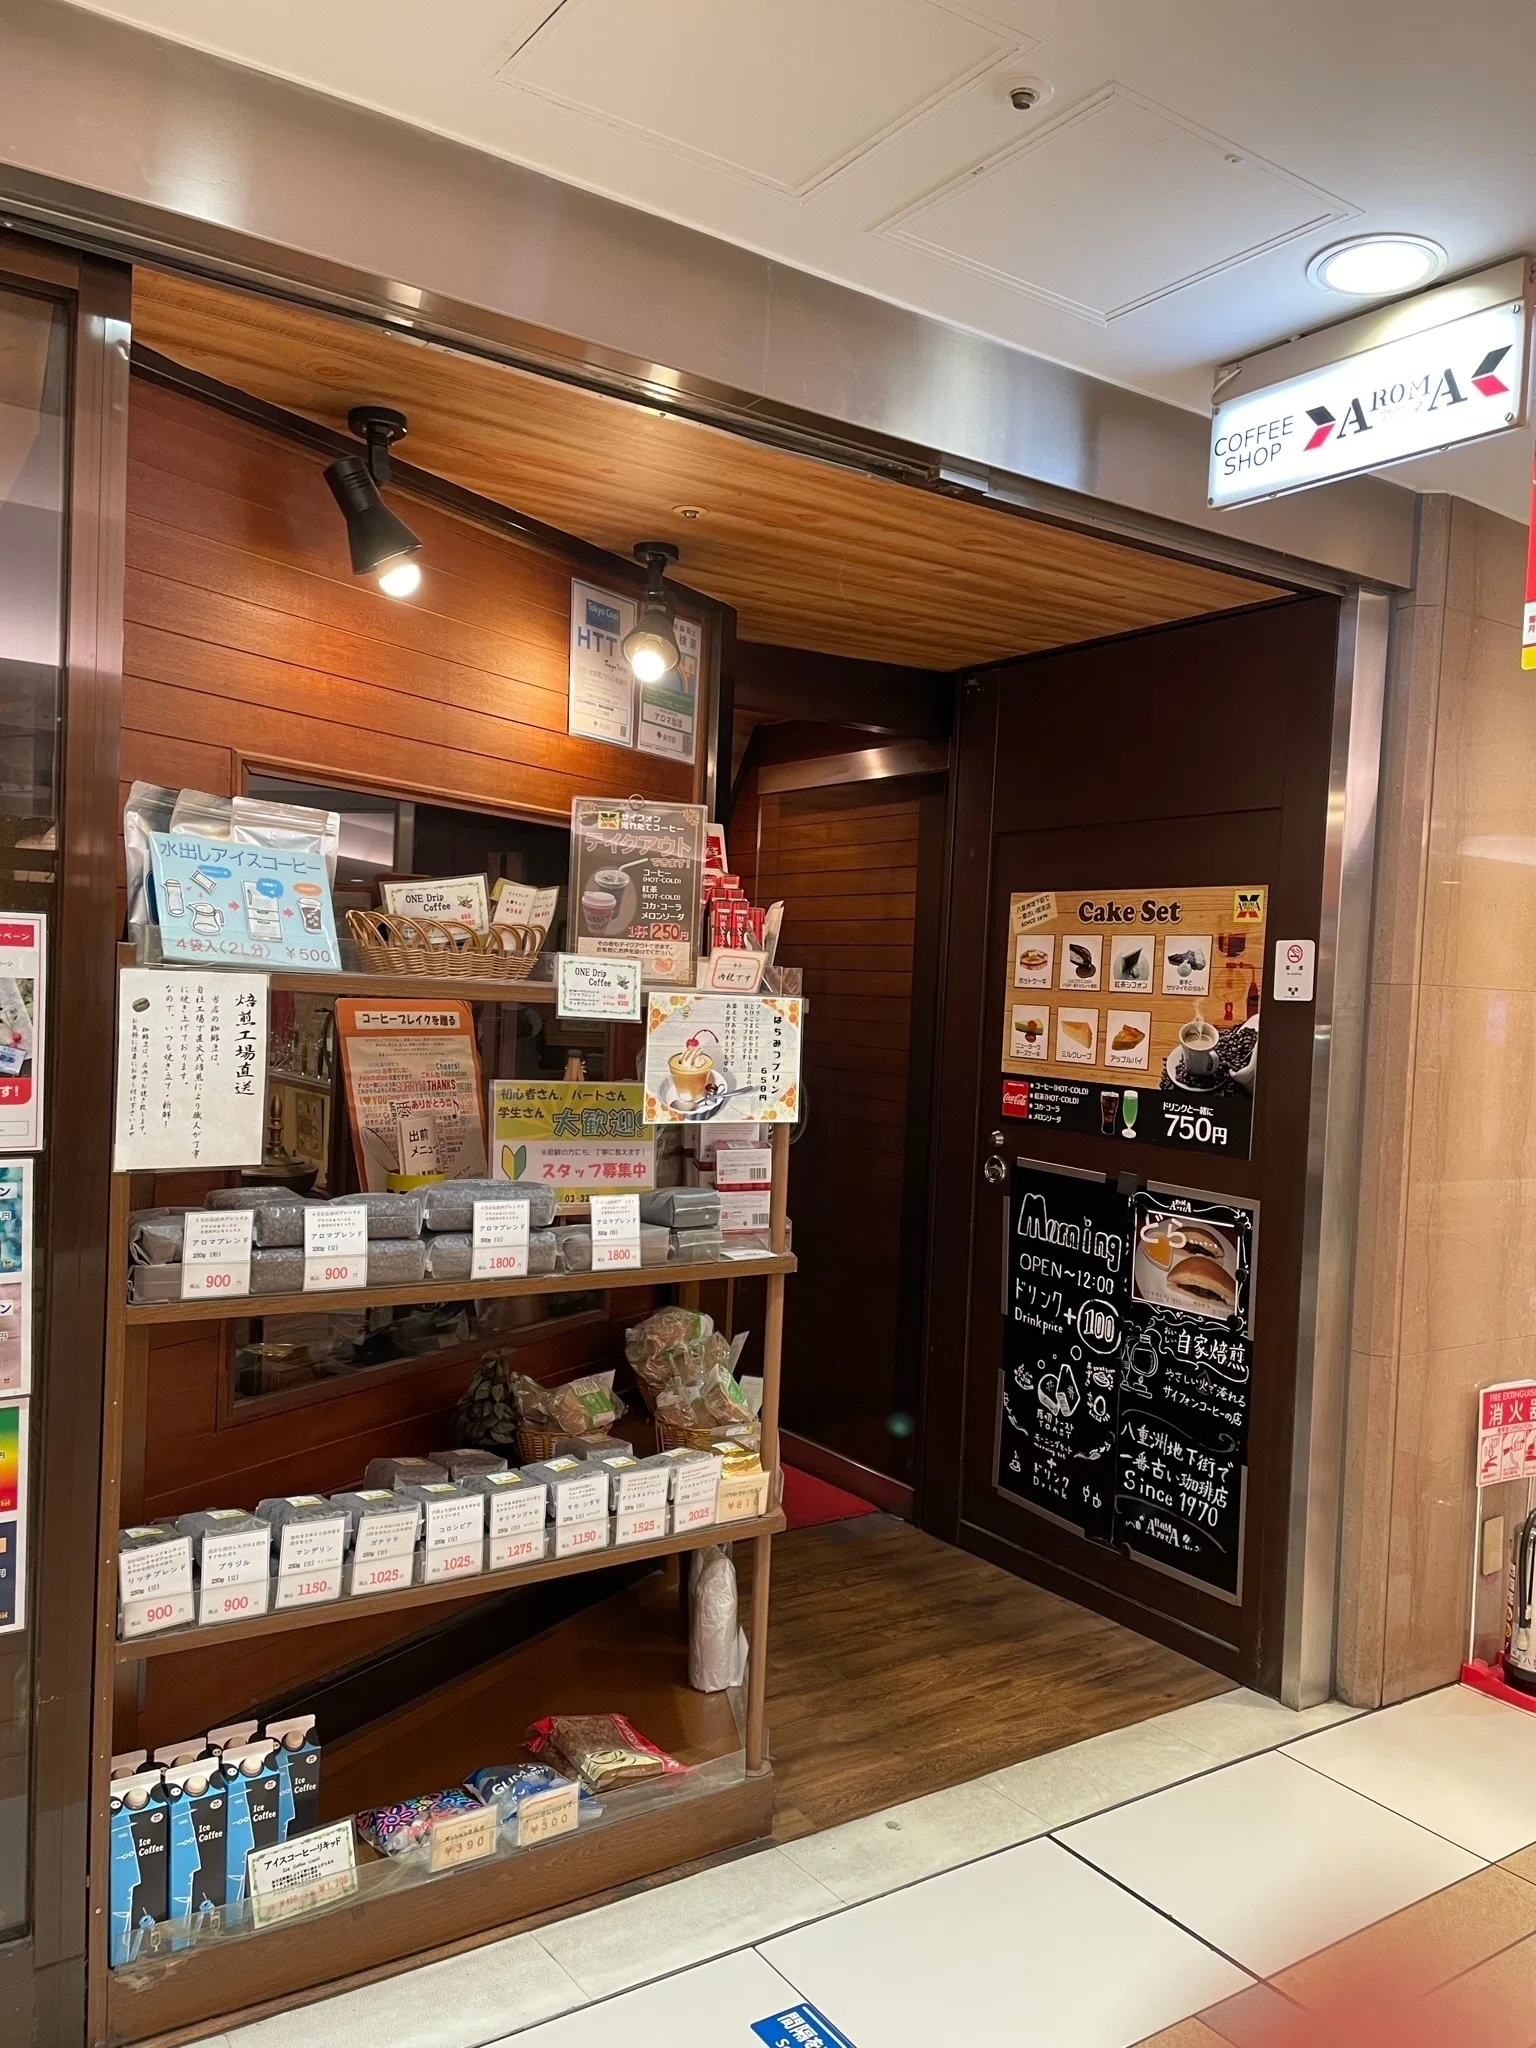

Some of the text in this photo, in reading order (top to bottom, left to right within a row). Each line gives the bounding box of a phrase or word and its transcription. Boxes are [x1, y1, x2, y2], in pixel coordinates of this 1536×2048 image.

[1336, 367, 1469, 440] AROMA
[1214, 415, 1295, 457] COFFEE
[1223, 442, 1283, 476] SHOP
[577, 626, 618, 657] HTT
[621, 813, 661, 823] サイフォン
[584, 831, 692, 858] テイクアウト
[159, 840, 321, 875] 水出しアイスコーヒー
[642, 869, 672, 877] コーヒー
[642, 885, 658, 893] 紅茶
[405, 893, 445, 905] ONE Drip
[423, 902, 451, 913] Coffee
[641, 902, 682, 911] コカ・コーラ
[1078, 899, 1182, 923] Cake Set
[641, 912, 685, 921] メロンソーダ
[176, 938, 331, 963] 4袋入(2L分) ¥500
[574, 967, 607, 978] ONE Drip
[588, 977, 612, 988] Coffee
[1018, 977, 1047, 985] ホットケーキ
[1114, 980, 1148, 989] 紅茶シフォン
[362, 1013, 456, 1027] コーヒーブレイクを贈る
[234, 992, 258, 1097] 焙煎工場直送
[1015, 1042, 1041, 1050] ニューヨーク
[771, 1016, 783, 1095] はちみつプリン
[1015, 1049, 1040, 1057] チーズケーキ
[1061, 1050, 1092, 1060] ミルクレープ
[1110, 1054, 1143, 1065] アップルパイ
[435, 1062, 461, 1071] Cheers!
[426, 1079, 457, 1092] THANKS
[758, 1067, 768, 1101] 650円
[411, 1099, 447, 1109] ありがとう
[1034, 1103, 1061, 1113] コカ・コーラ
[1162, 1100, 1214, 1117] ドリンクと一緒に
[497, 1106, 545, 1119] 学生さん
[1033, 1113, 1062, 1124] メロンソーダ
[408, 1127, 429, 1143] 出前
[1163, 1113, 1228, 1145] 750円
[542, 1162, 647, 1179] スタッフ募集中
[479, 1224, 525, 1233] アロマブレンド
[596, 1218, 637, 1226] アロマブレンド
[311, 1231, 363, 1240] アロマブレンド
[1139, 1212, 1188, 1249] どら
[192, 1237, 249, 1247] アロマブレンド
[608, 1249, 631, 1261] 1800
[489, 1257, 515, 1269] 1800
[324, 1266, 348, 1280] 900
[205, 1274, 231, 1289] 900
[1015, 1277, 1063, 1317] ドリンク
[1177, 1327, 1246, 1373] 自家焙煎
[1119, 1421, 1235, 1483] 八重洲地下街で
[1119, 1451, 1229, 1509] 一番古い珈琲店
[1122, 1469, 1218, 1527] Since 1970
[688, 1507, 710, 1522] 2025
[439, 1522, 473, 1533] コロンビア
[632, 1520, 655, 1534] 1525
[571, 1531, 597, 1546] 1150
[295, 1545, 333, 1556] マンデリン
[507, 1543, 533, 1558] 1275
[219, 1559, 250, 1571] ブラジル
[443, 1556, 471, 1571] 1025
[127, 1563, 187, 1585] リッチブレンド
[369, 1569, 400, 1585] 1025
[297, 1580, 327, 1596] 1150
[224, 1596, 249, 1612] 900
[146, 1605, 173, 1622] 900
[293, 1782, 317, 1794] Coffee
[294, 1777, 306, 1786] Ice
[491, 1768, 527, 1795] GUM
[252, 1803, 265, 1812] Ice
[252, 1810, 277, 1822] Coffee
[198, 1824, 211, 1834] Ice
[530, 1813, 569, 1834] ¥300
[138, 1837, 151, 1846] Ice
[198, 1830, 223, 1843] Coffee
[138, 1844, 164, 1857] Coffee
[264, 1836, 342, 1872] アイスコーヒーリキッド
